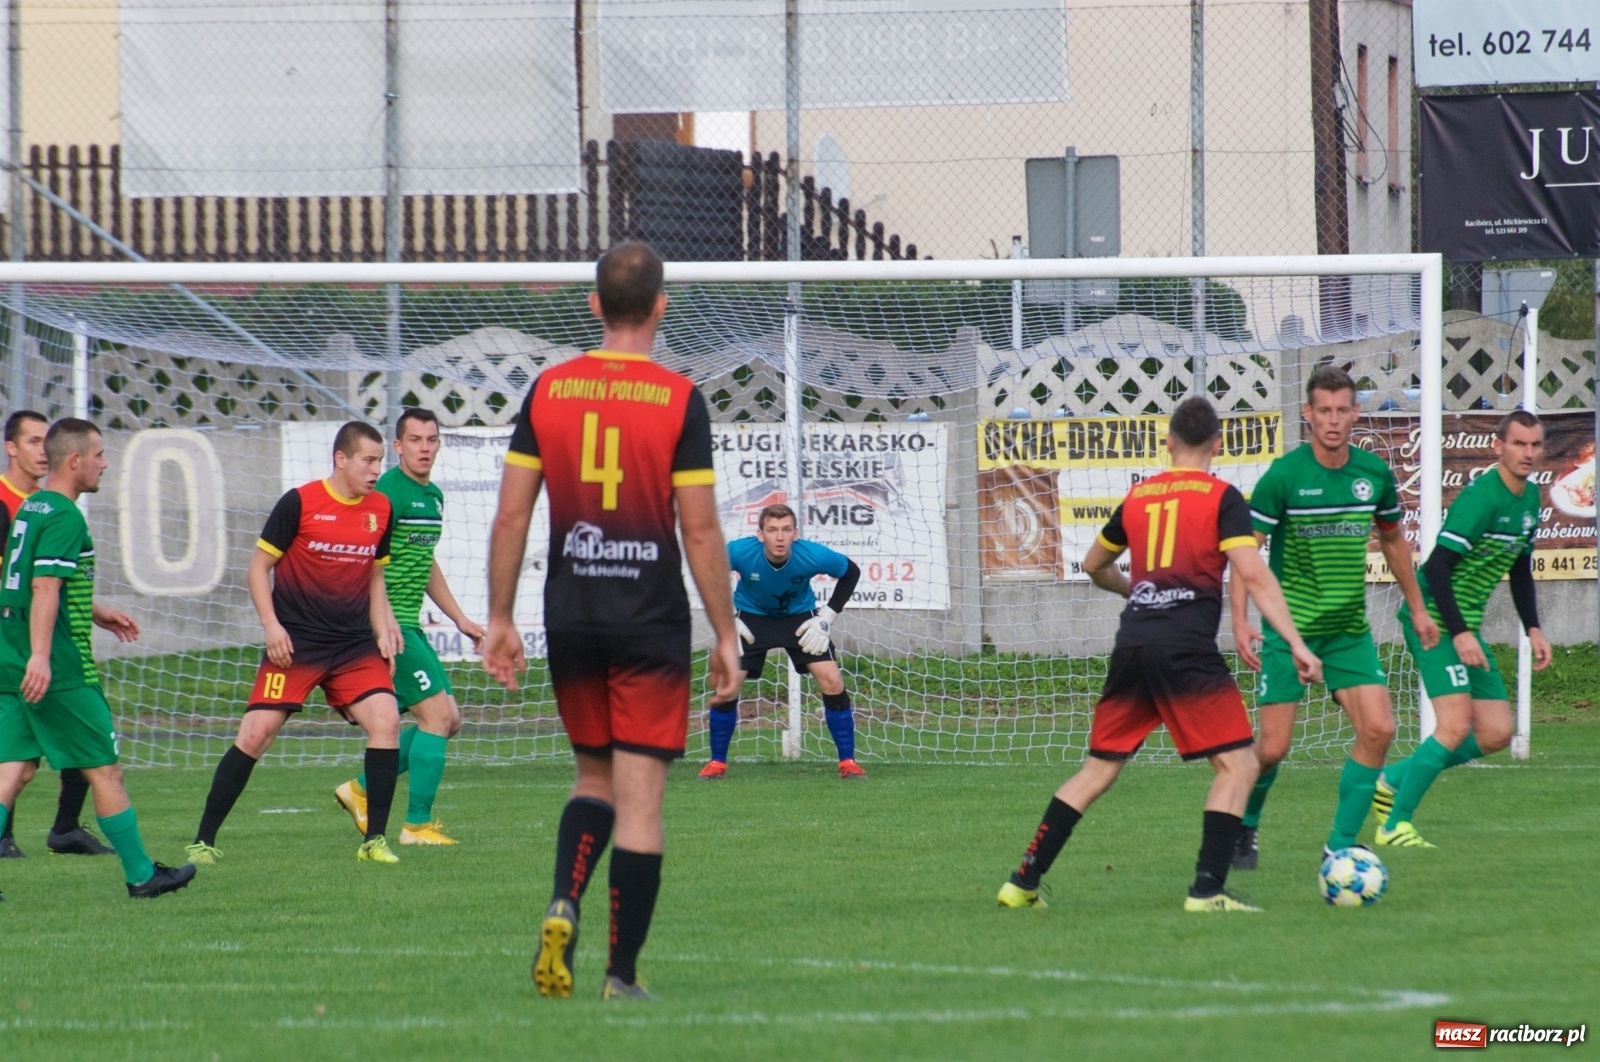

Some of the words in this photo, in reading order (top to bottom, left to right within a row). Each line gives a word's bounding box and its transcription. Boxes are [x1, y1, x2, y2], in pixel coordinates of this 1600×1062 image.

[1429, 32, 1471, 57] tel.
[1483, 30, 1531, 56] 602
[1542, 28, 1591, 53] 744
[1503, 218, 1541, 226] Mickiewicza
[580, 410, 624, 511] 4
[738, 460, 885, 479] CIESELSKIE
[1145, 498, 1180, 573] 11
[4, 519, 28, 591] 2
[1551, 556, 1575, 570] 441
[868, 562, 915, 582] 012
[894, 588, 904, 602] 8
[262, 672, 287, 700] 19
[412, 669, 432, 692] 3
[1445, 665, 1469, 687] 13
